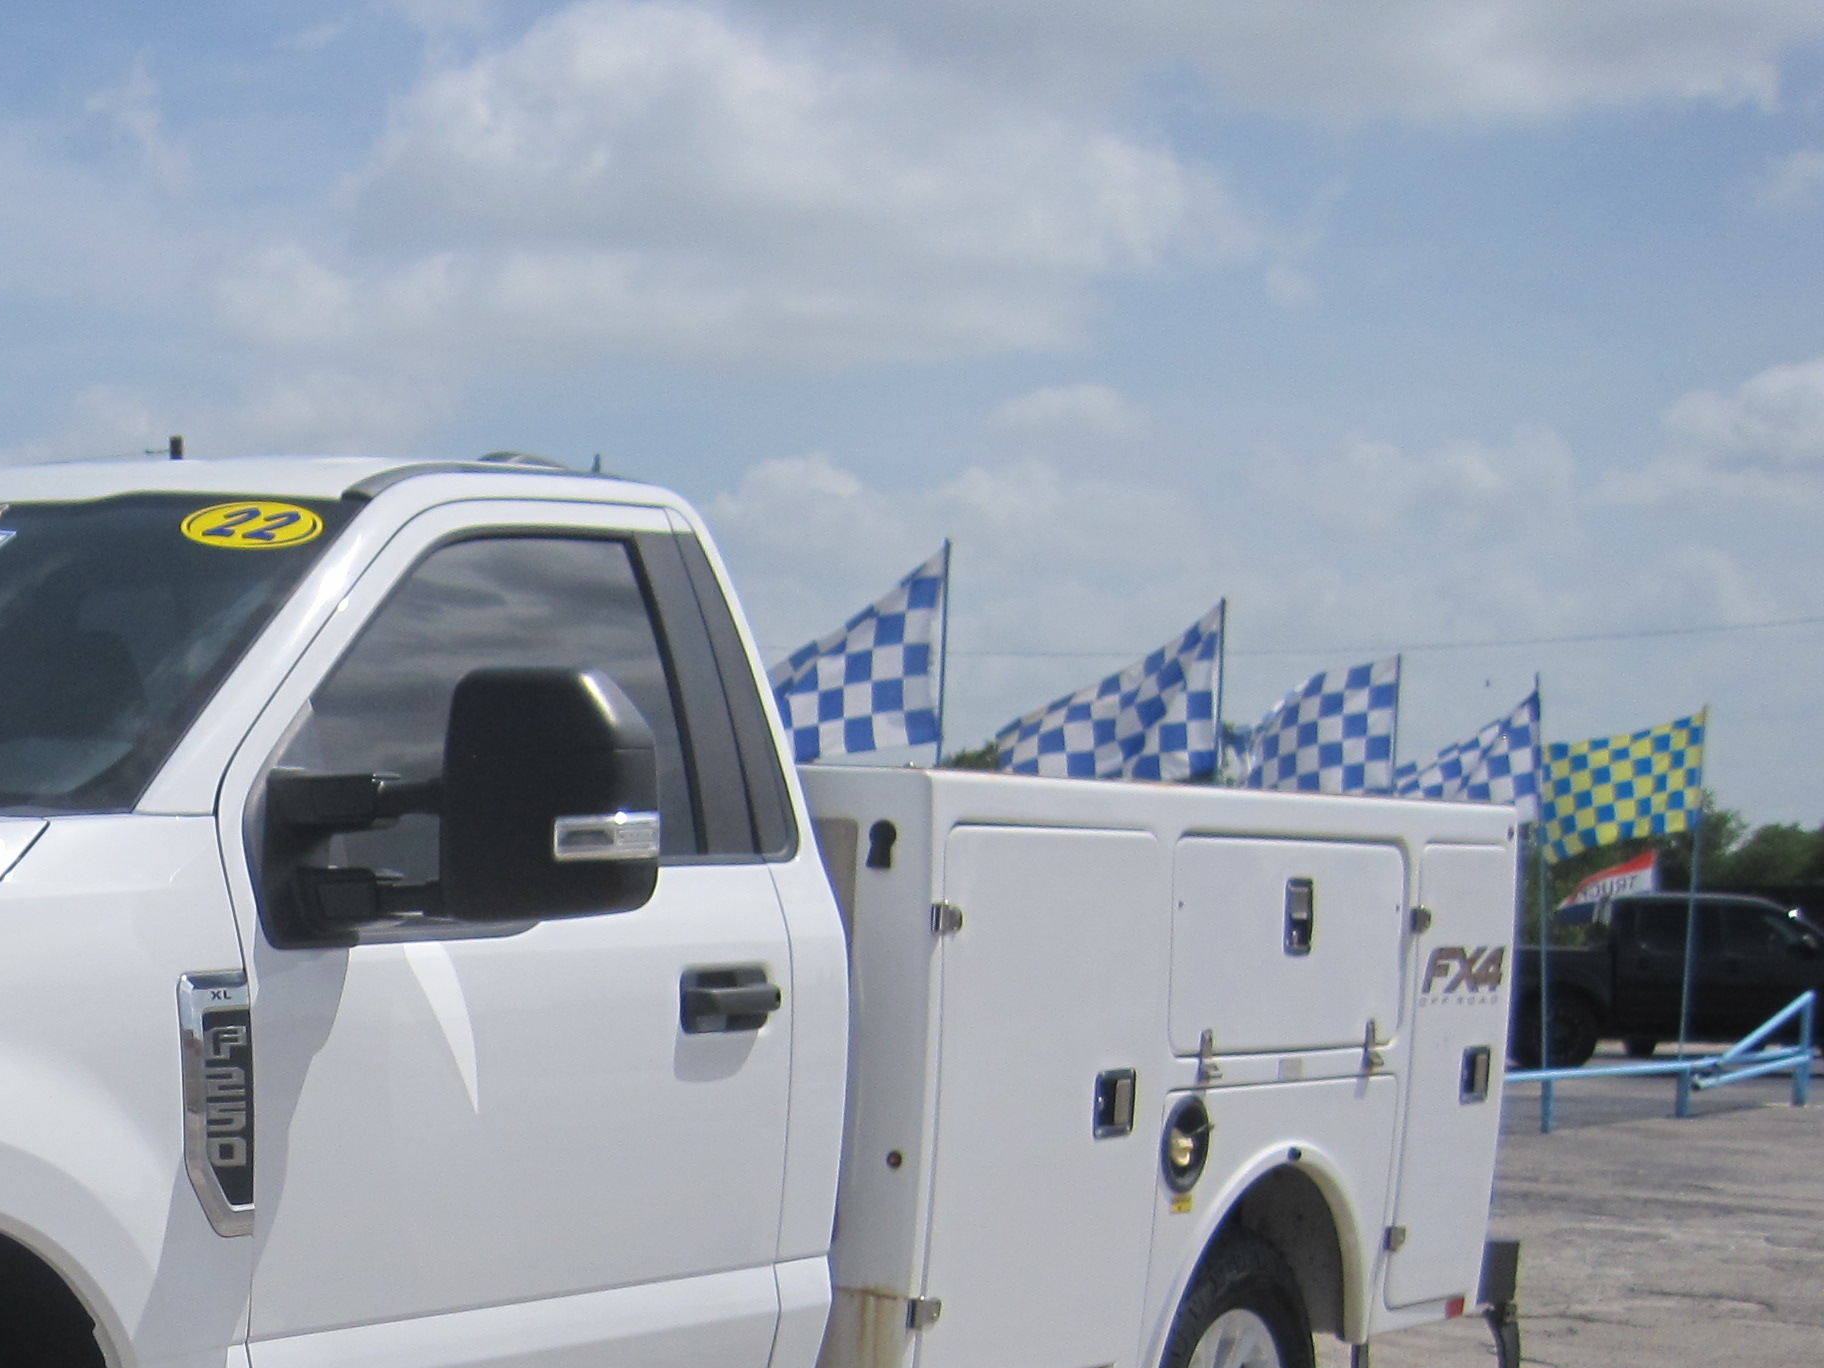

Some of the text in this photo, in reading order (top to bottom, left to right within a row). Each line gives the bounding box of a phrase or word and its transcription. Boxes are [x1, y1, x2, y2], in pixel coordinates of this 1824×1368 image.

[201, 507, 301, 540] 22
[1421, 945, 1506, 994] FX4
[210, 990, 232, 1000] XL
[204, 1027, 247, 1167] F250
